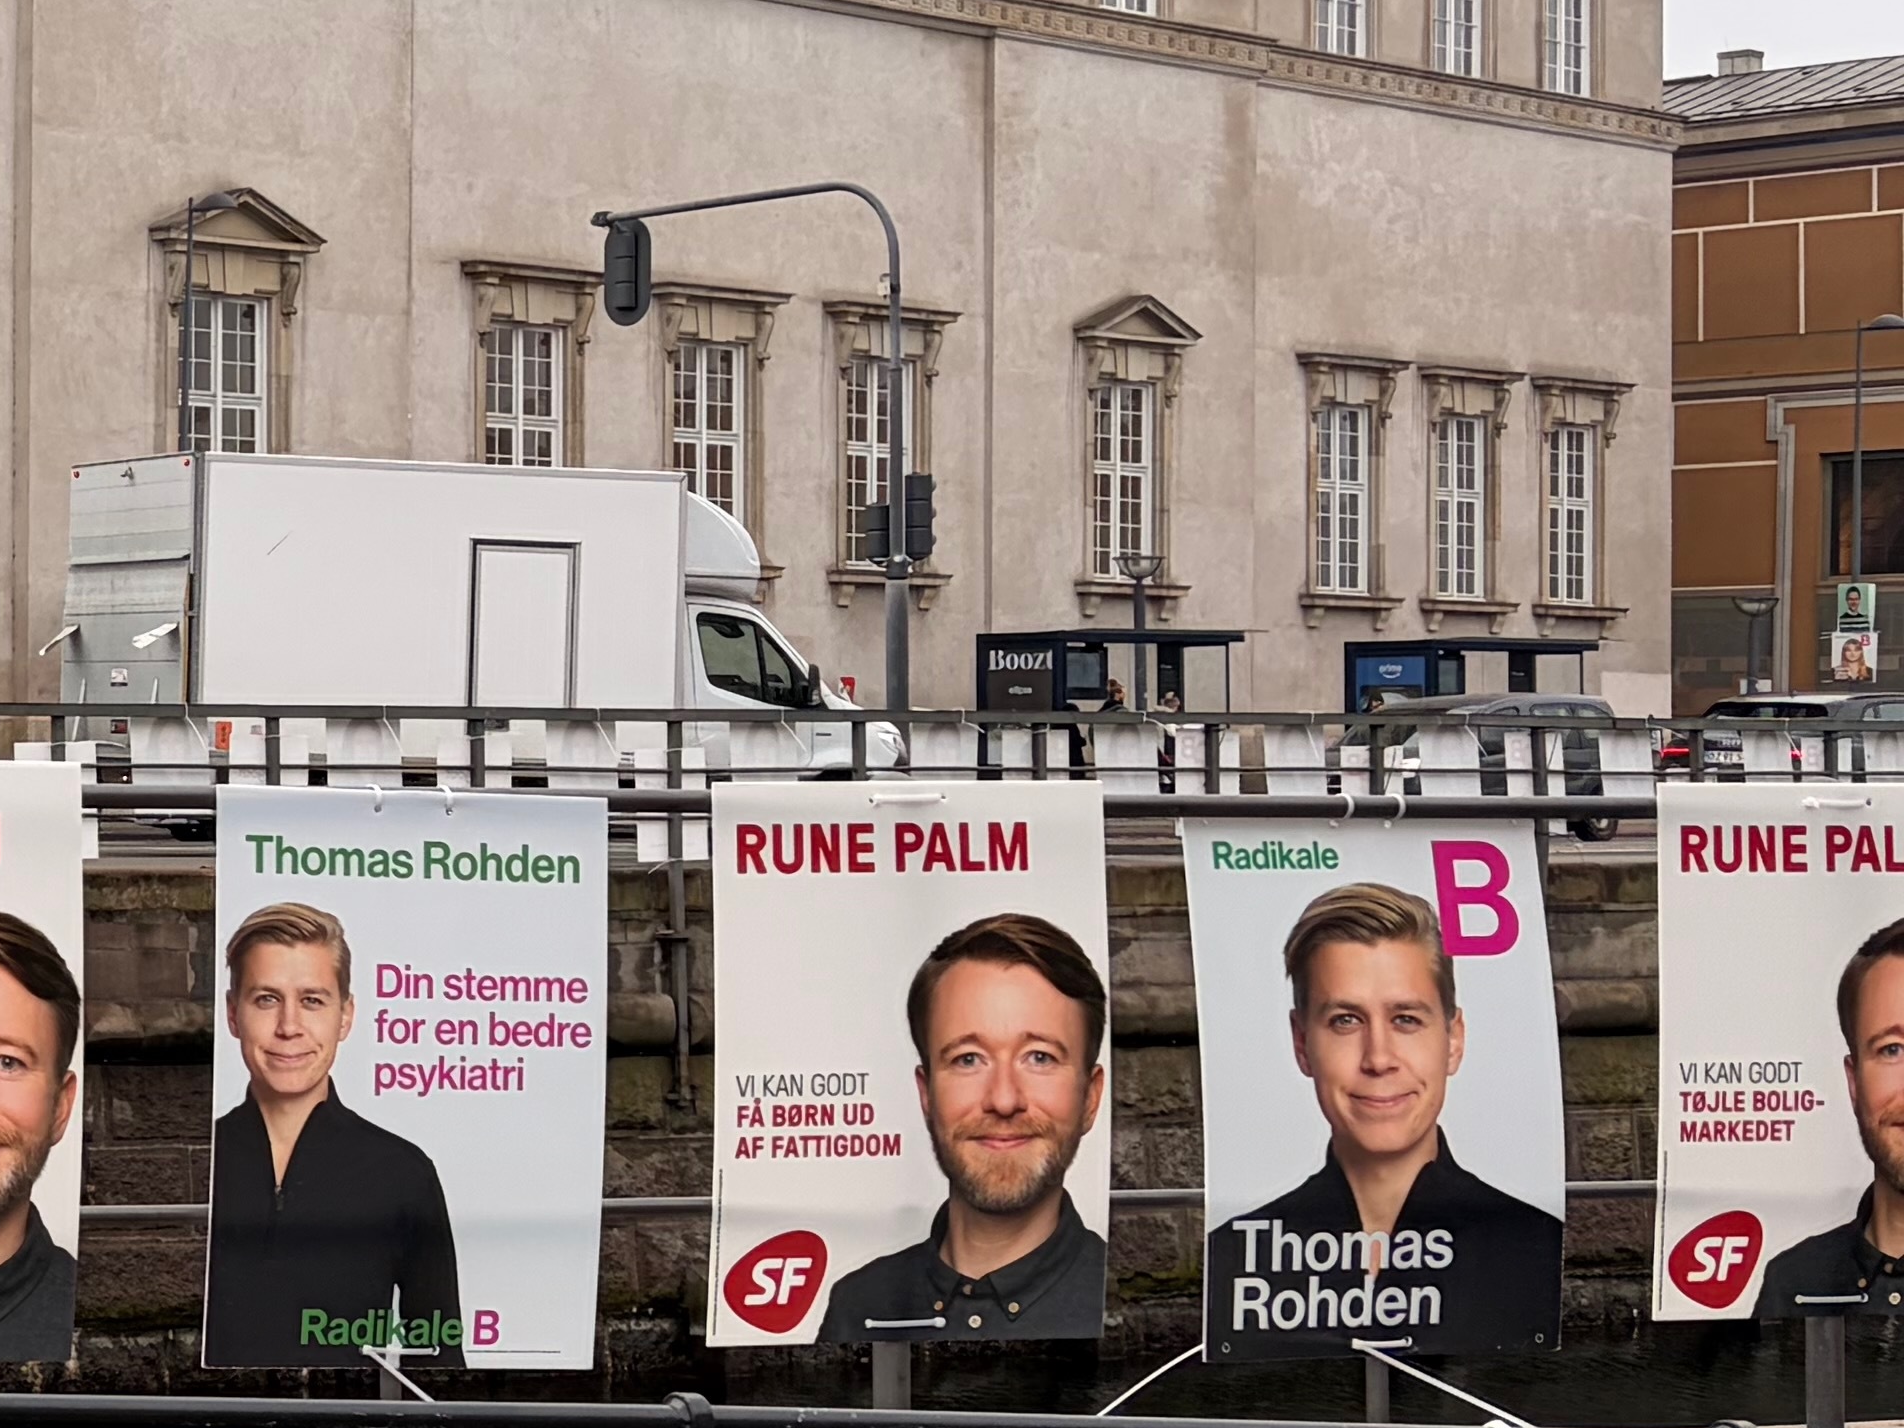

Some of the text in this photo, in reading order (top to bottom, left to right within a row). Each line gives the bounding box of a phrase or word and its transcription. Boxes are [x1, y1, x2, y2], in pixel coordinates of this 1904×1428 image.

[247, 835, 581, 883] Thomas Rohden
[737, 823, 1029, 875] RUNE PALM
[1681, 826, 1808, 873] RUNE
[1214, 841, 1519, 957] Radikale B
[377, 965, 586, 1001] Din stemme
[378, 1013, 589, 1046] for en bedre
[376, 1061, 522, 1094] psykiatri
[736, 1073, 869, 1098] VI KAN GODT
[1679, 1062, 1802, 1084] VI KAN GODT
[738, 1099, 874, 1127] FÅ BØRN UD
[1680, 1090, 1825, 1113] TØJLE BOLIG-
[737, 1136, 901, 1157] AF FATTIGDOM
[1681, 1121, 1792, 1141] MARKEDET
[1233, 1220, 1453, 1273] Thomas
[1687, 1236, 1749, 1283] SF
[744, 1258, 813, 1306] SF
[1234, 1276, 1439, 1329] Rohden
[303, 1311, 499, 1345] Radikale B
